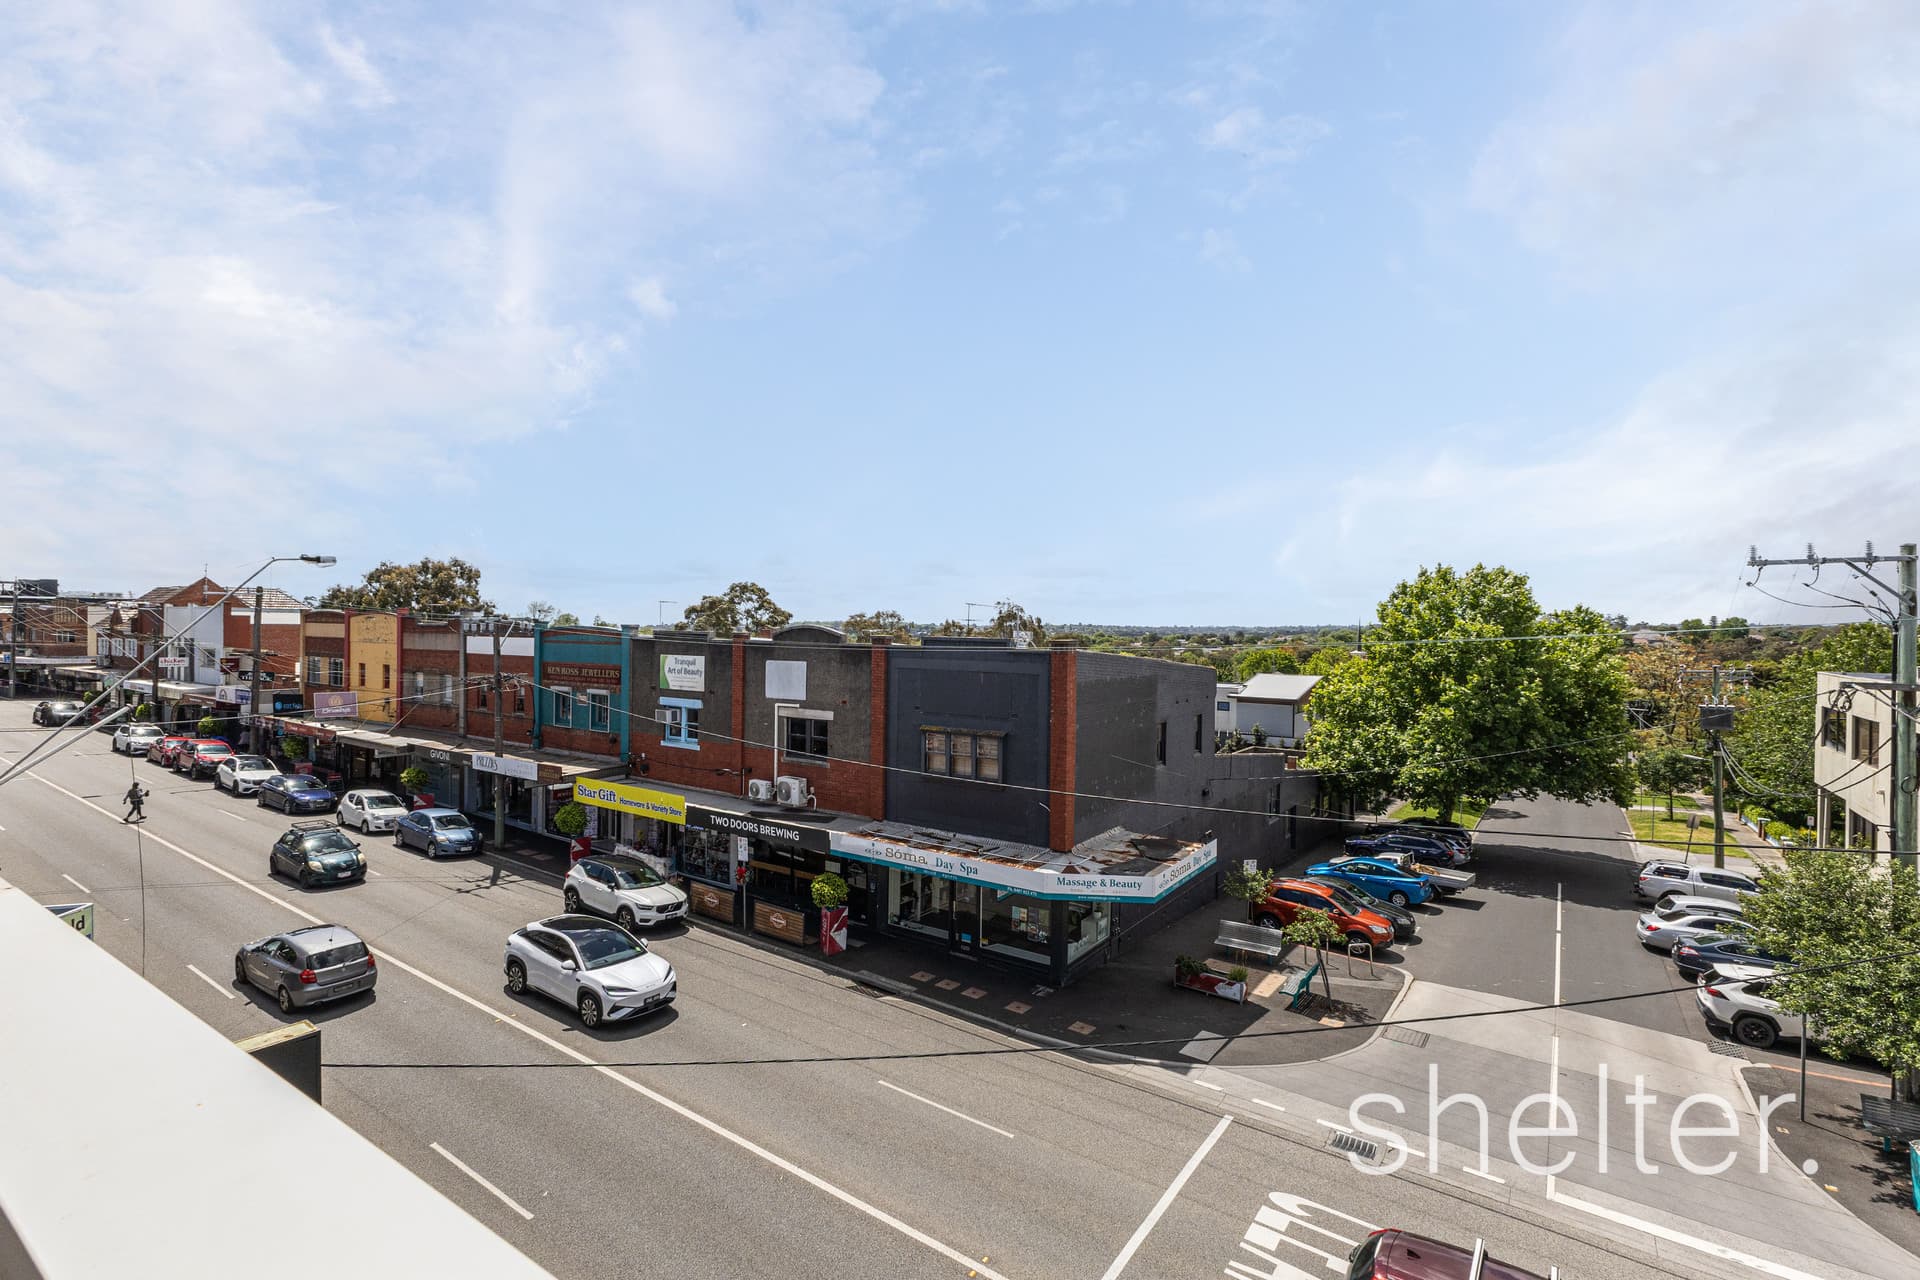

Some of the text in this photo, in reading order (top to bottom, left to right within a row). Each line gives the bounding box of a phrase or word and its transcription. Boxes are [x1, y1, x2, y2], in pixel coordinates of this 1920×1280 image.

[674, 657, 697, 668] Tranquil
[547, 666, 620, 678] KEN ROSS JEWELLERS
[684, 667, 703, 678] Beauty
[577, 784, 597, 799] Star
[598, 788, 617, 803] Gift
[651, 803, 669, 816] Variety
[669, 806, 682, 817] Store
[710, 815, 730, 828] TWO
[730, 820, 759, 833] DOORS
[760, 824, 800, 841] BREWING
[936, 857, 955, 872] Day
[959, 862, 979, 876] Spa
[1056, 877, 1143, 891] Massage & Beauty
